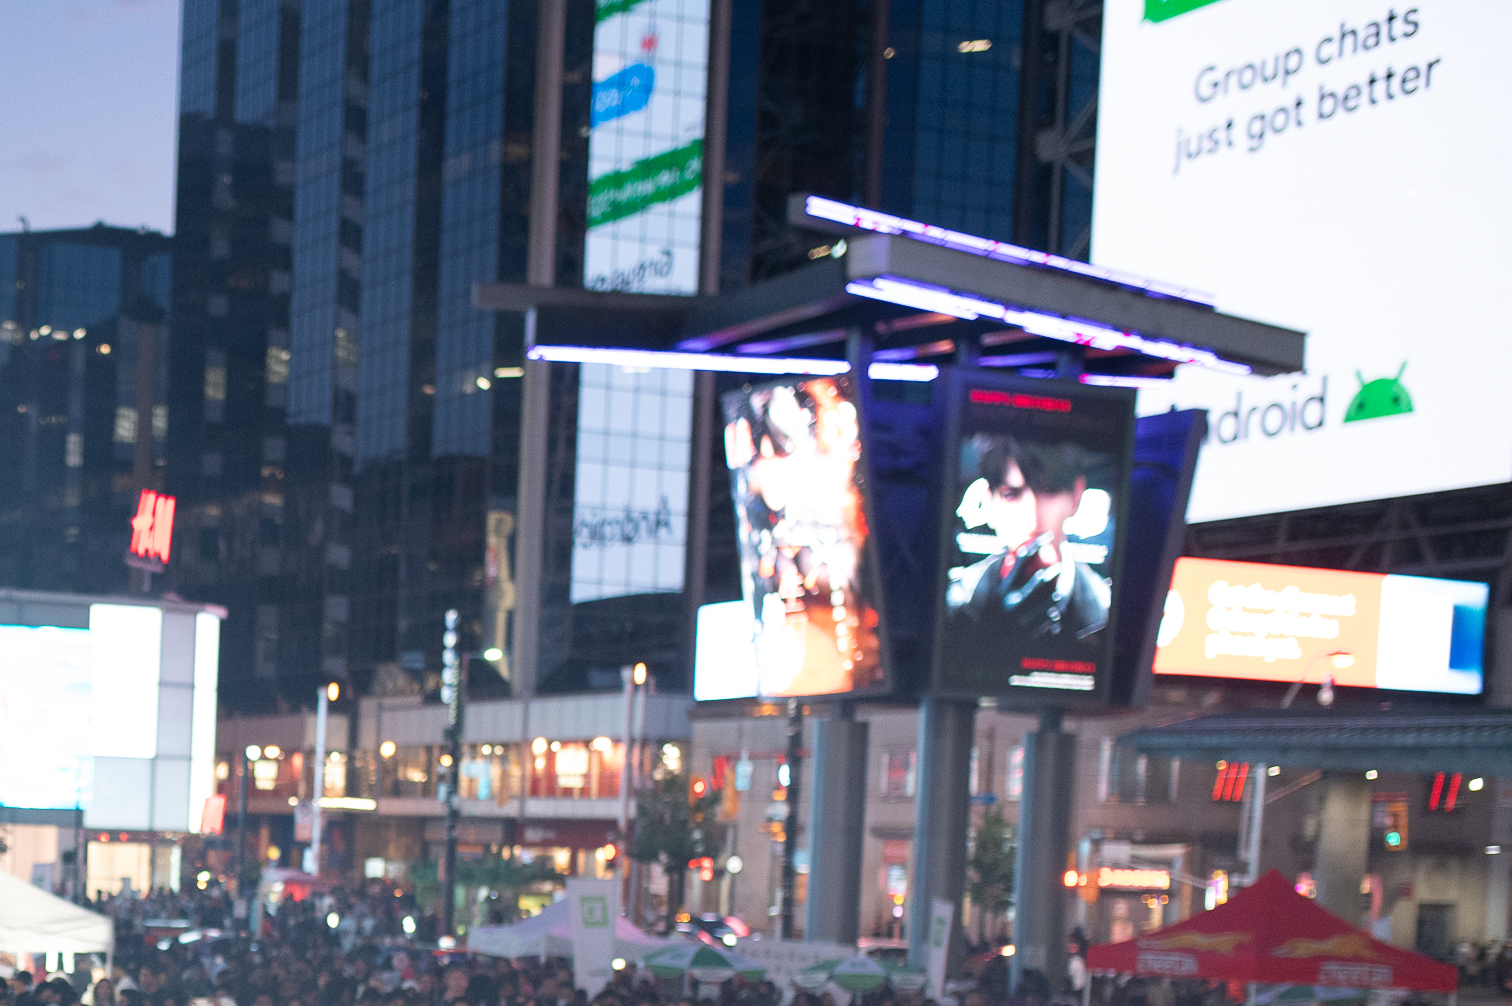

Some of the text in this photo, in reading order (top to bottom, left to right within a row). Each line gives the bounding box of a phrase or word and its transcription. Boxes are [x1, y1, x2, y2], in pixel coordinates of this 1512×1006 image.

[1194, 7, 1420, 103] Group chats
[1173, 57, 1442, 177] just got better
[1202, 376, 1329, 445] droid
